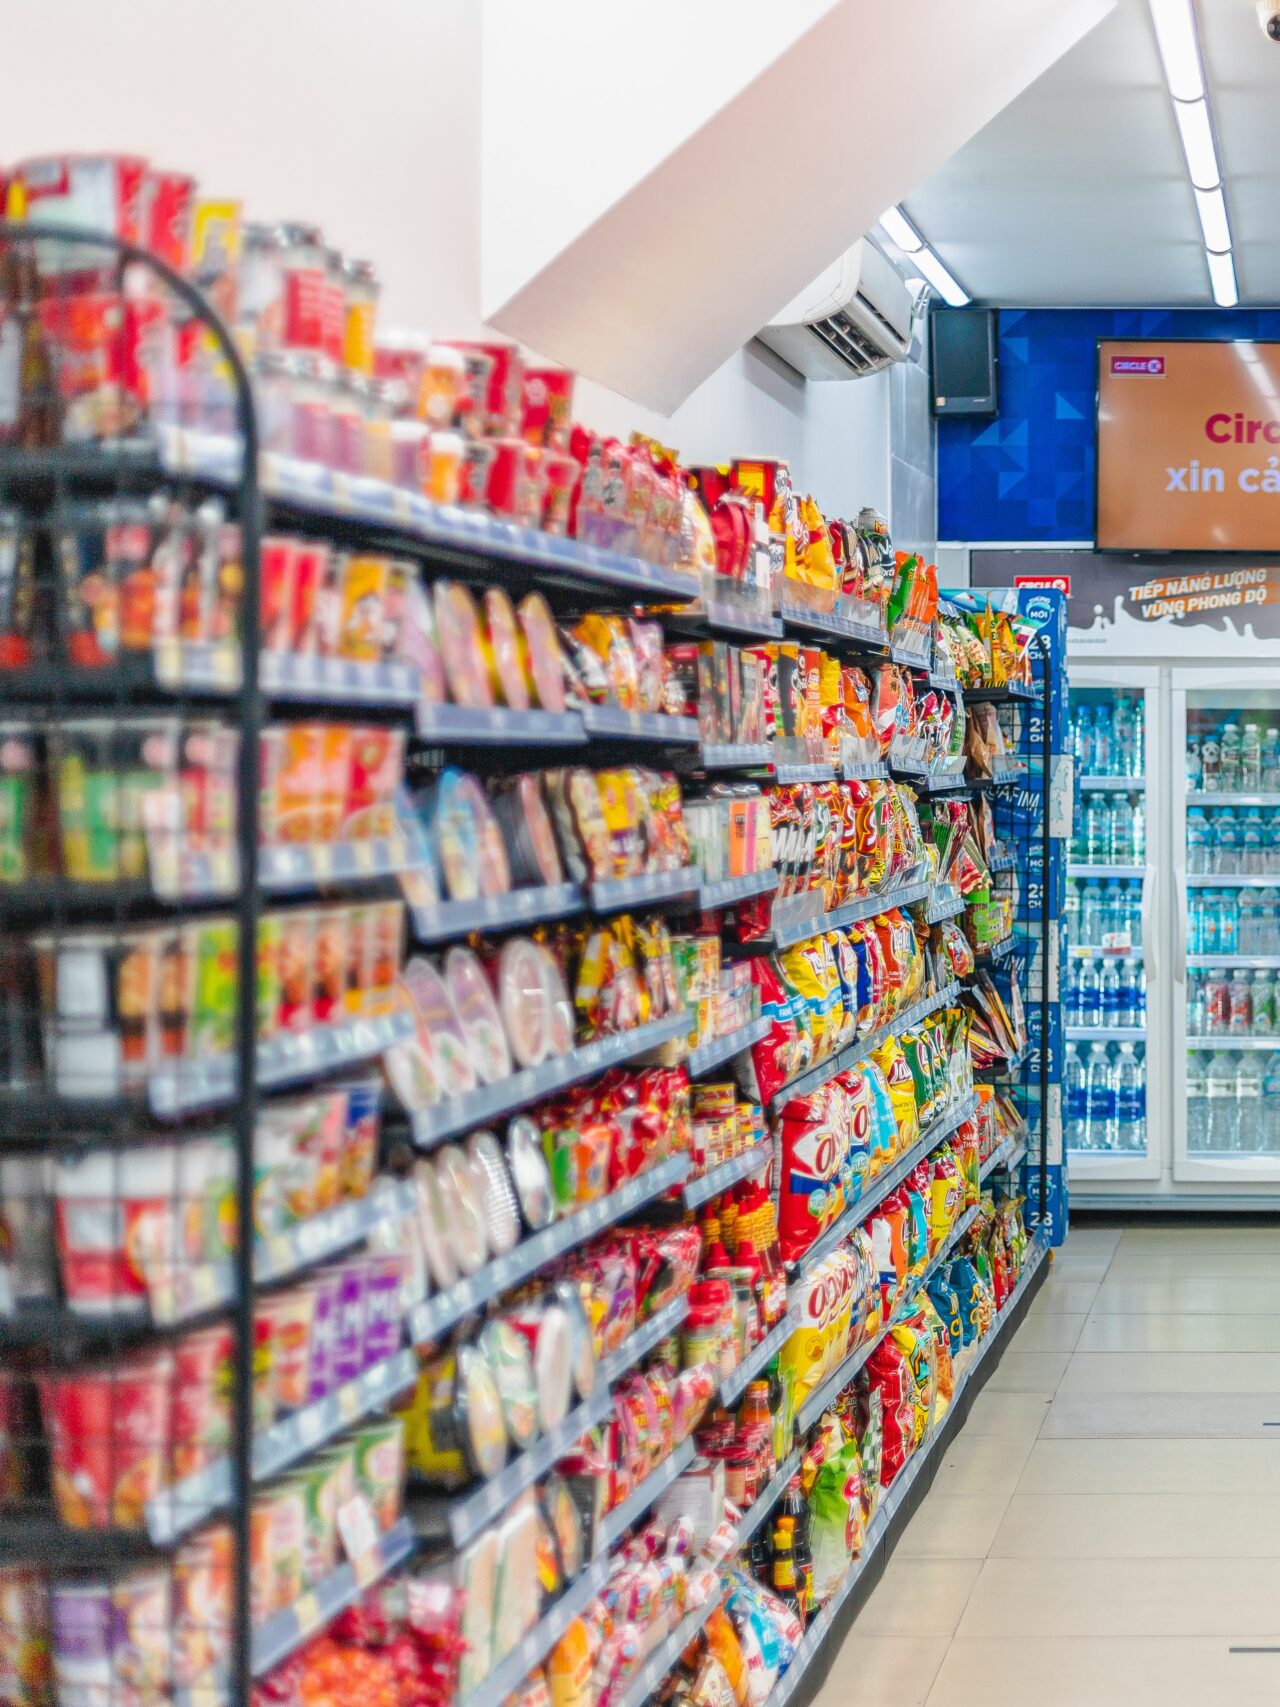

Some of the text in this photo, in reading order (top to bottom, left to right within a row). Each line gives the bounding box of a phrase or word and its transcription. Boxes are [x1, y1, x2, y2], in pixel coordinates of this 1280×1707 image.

[1165, 460, 1224, 492] xin
[1129, 579, 1161, 601] TIẾP
[1166, 571, 1212, 597] NĂNG
[1214, 569, 1268, 591] LƯỢNG
[1142, 598, 1186, 618] VỮNG
[1187, 591, 1243, 612] PHONG
[1244, 585, 1268, 606] ĐỘ
